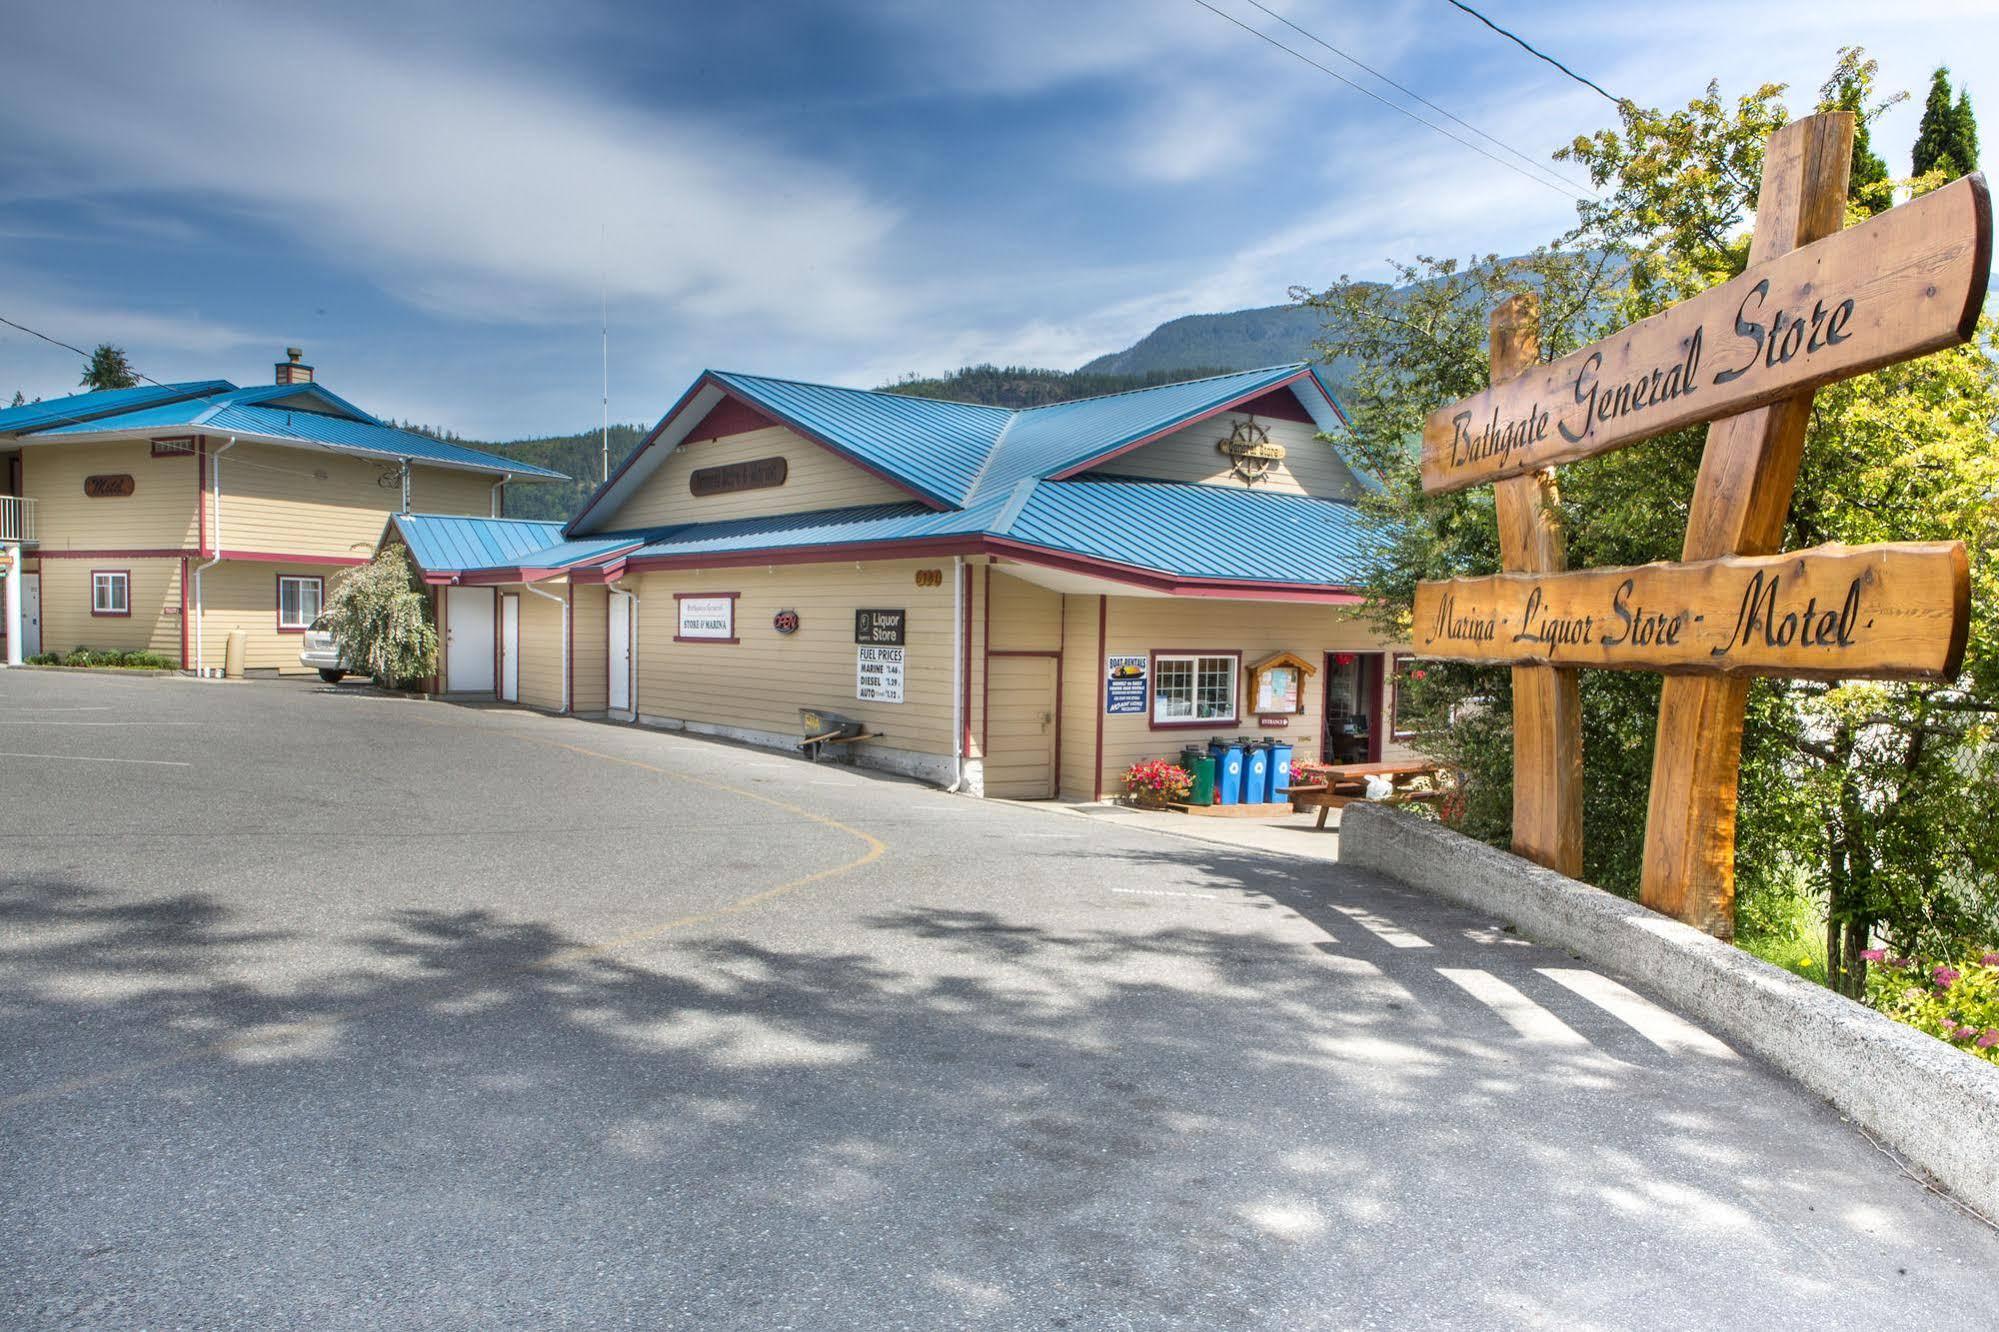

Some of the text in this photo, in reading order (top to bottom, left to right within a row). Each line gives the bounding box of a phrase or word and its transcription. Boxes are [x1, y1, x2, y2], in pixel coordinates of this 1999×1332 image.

[1450, 278, 1855, 469] Bathgate General Store
[1425, 591, 1496, 645] Marina
[1513, 586, 1592, 657] Liquor
[1600, 578, 1682, 647] Store
[1710, 569, 1860, 656] Motel
[684, 619, 699, 629] STORE
[705, 619, 727, 630] MARINA
[776, 615, 797, 629] OPEN
[872, 612, 899, 629] Liquor
[872, 627, 897, 641] Store
[860, 648, 902, 661] FUEL PRICES
[861, 663, 883, 674] MARINE
[1110, 657, 1146, 669] BOAT RENTALS
[860, 675, 881, 687] DIESEL
[860, 688, 875, 698] AUTO
